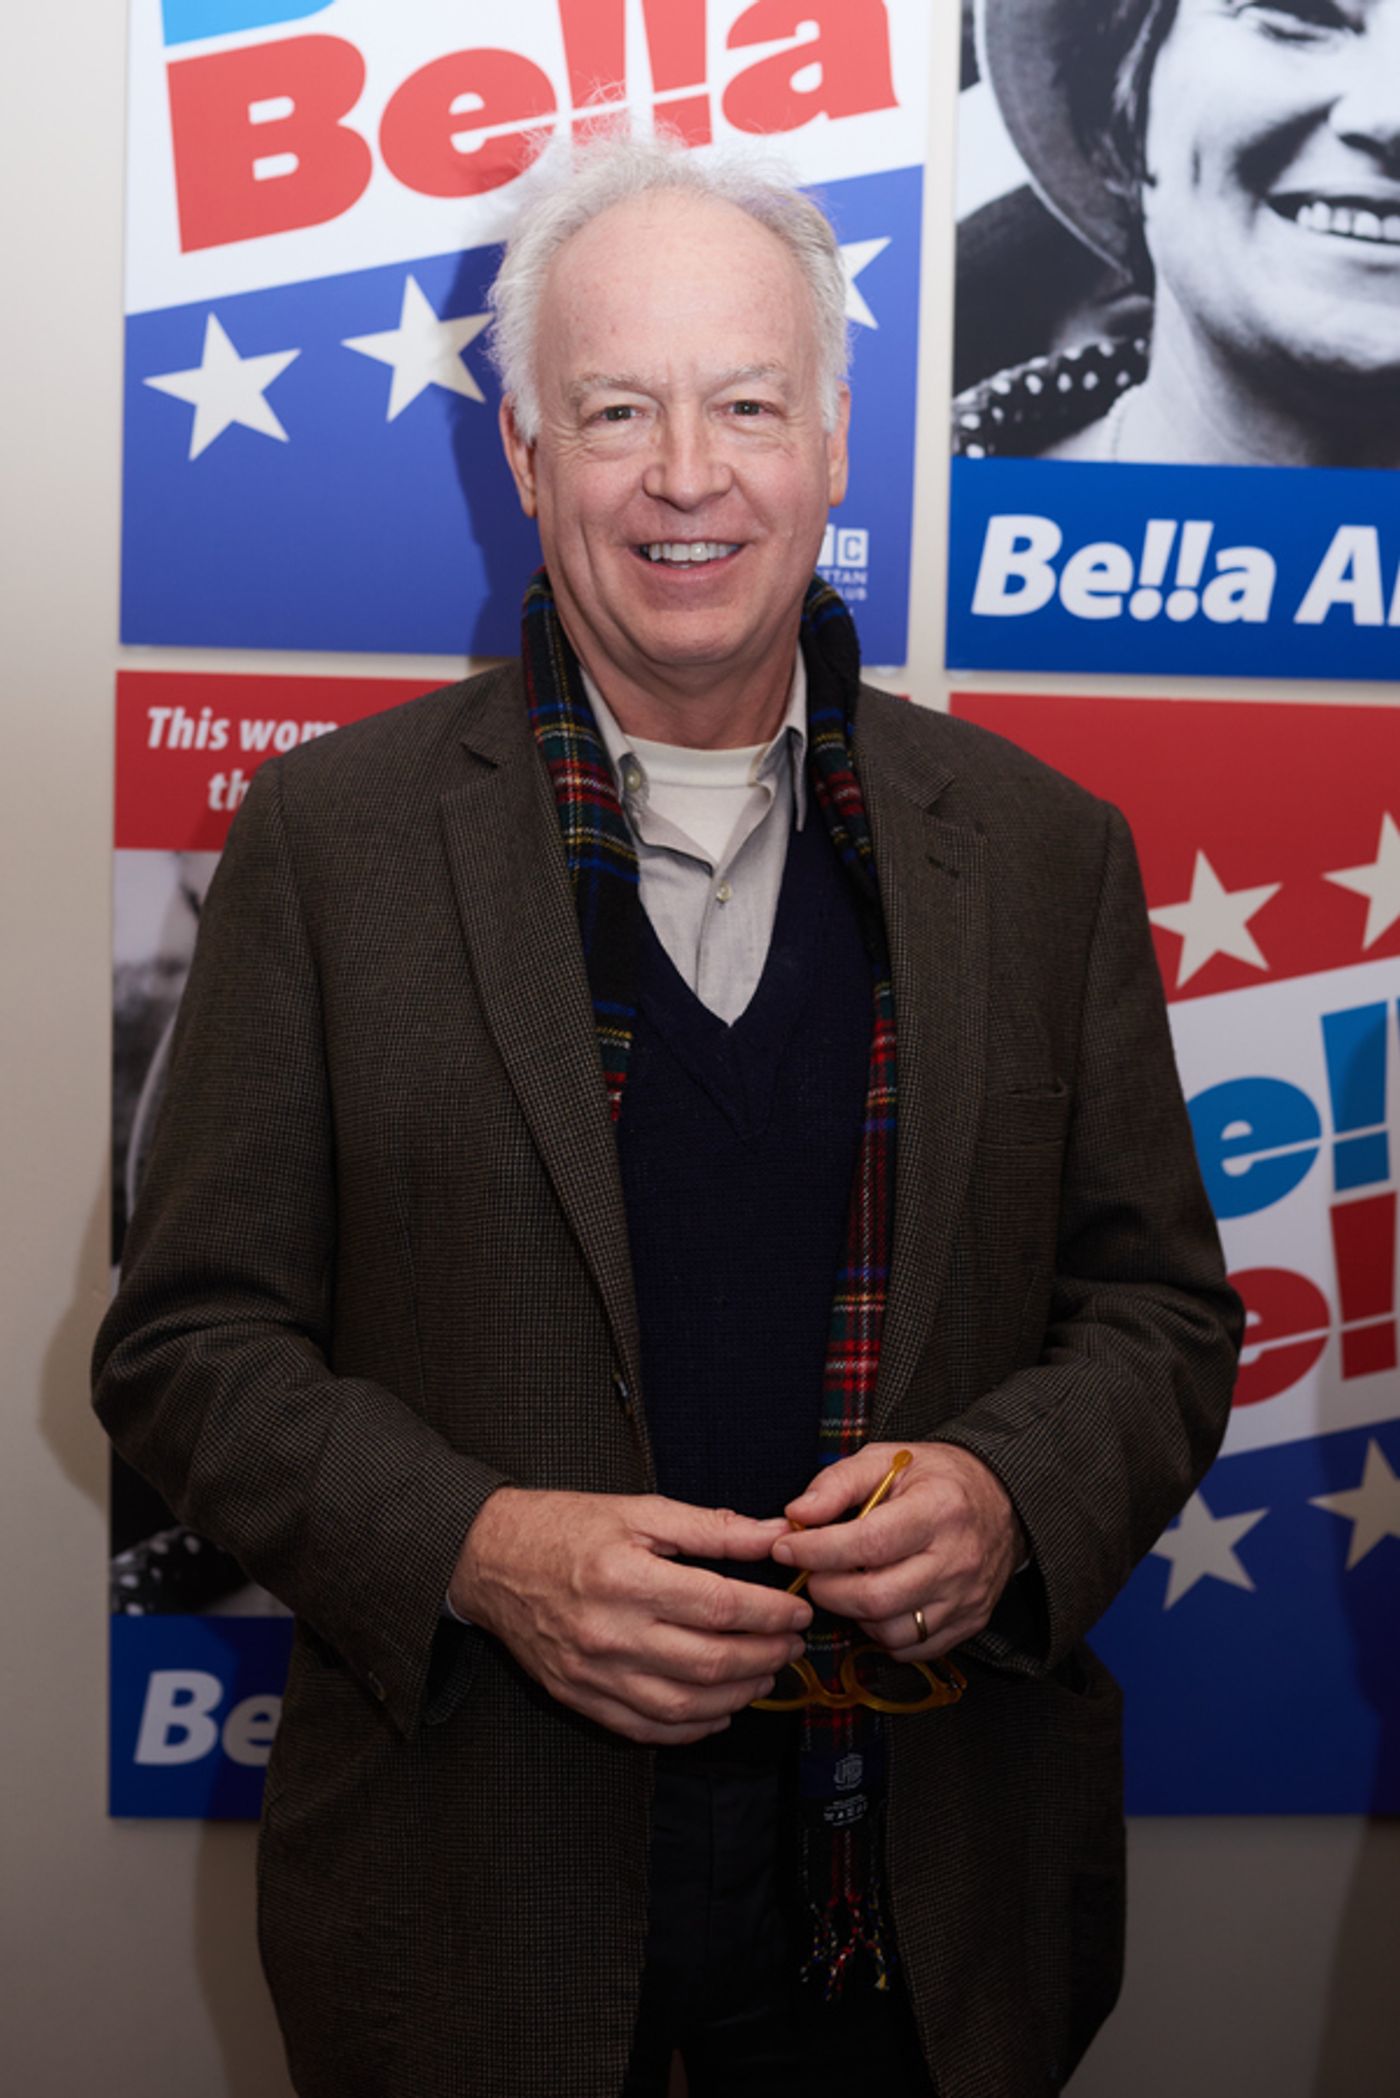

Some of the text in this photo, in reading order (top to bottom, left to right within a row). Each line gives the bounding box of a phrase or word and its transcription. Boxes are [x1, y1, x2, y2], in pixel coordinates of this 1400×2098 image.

[1294, 525, 1400, 627] A
[147, 706, 230, 750] This
[133, 1669, 283, 1767] Be
